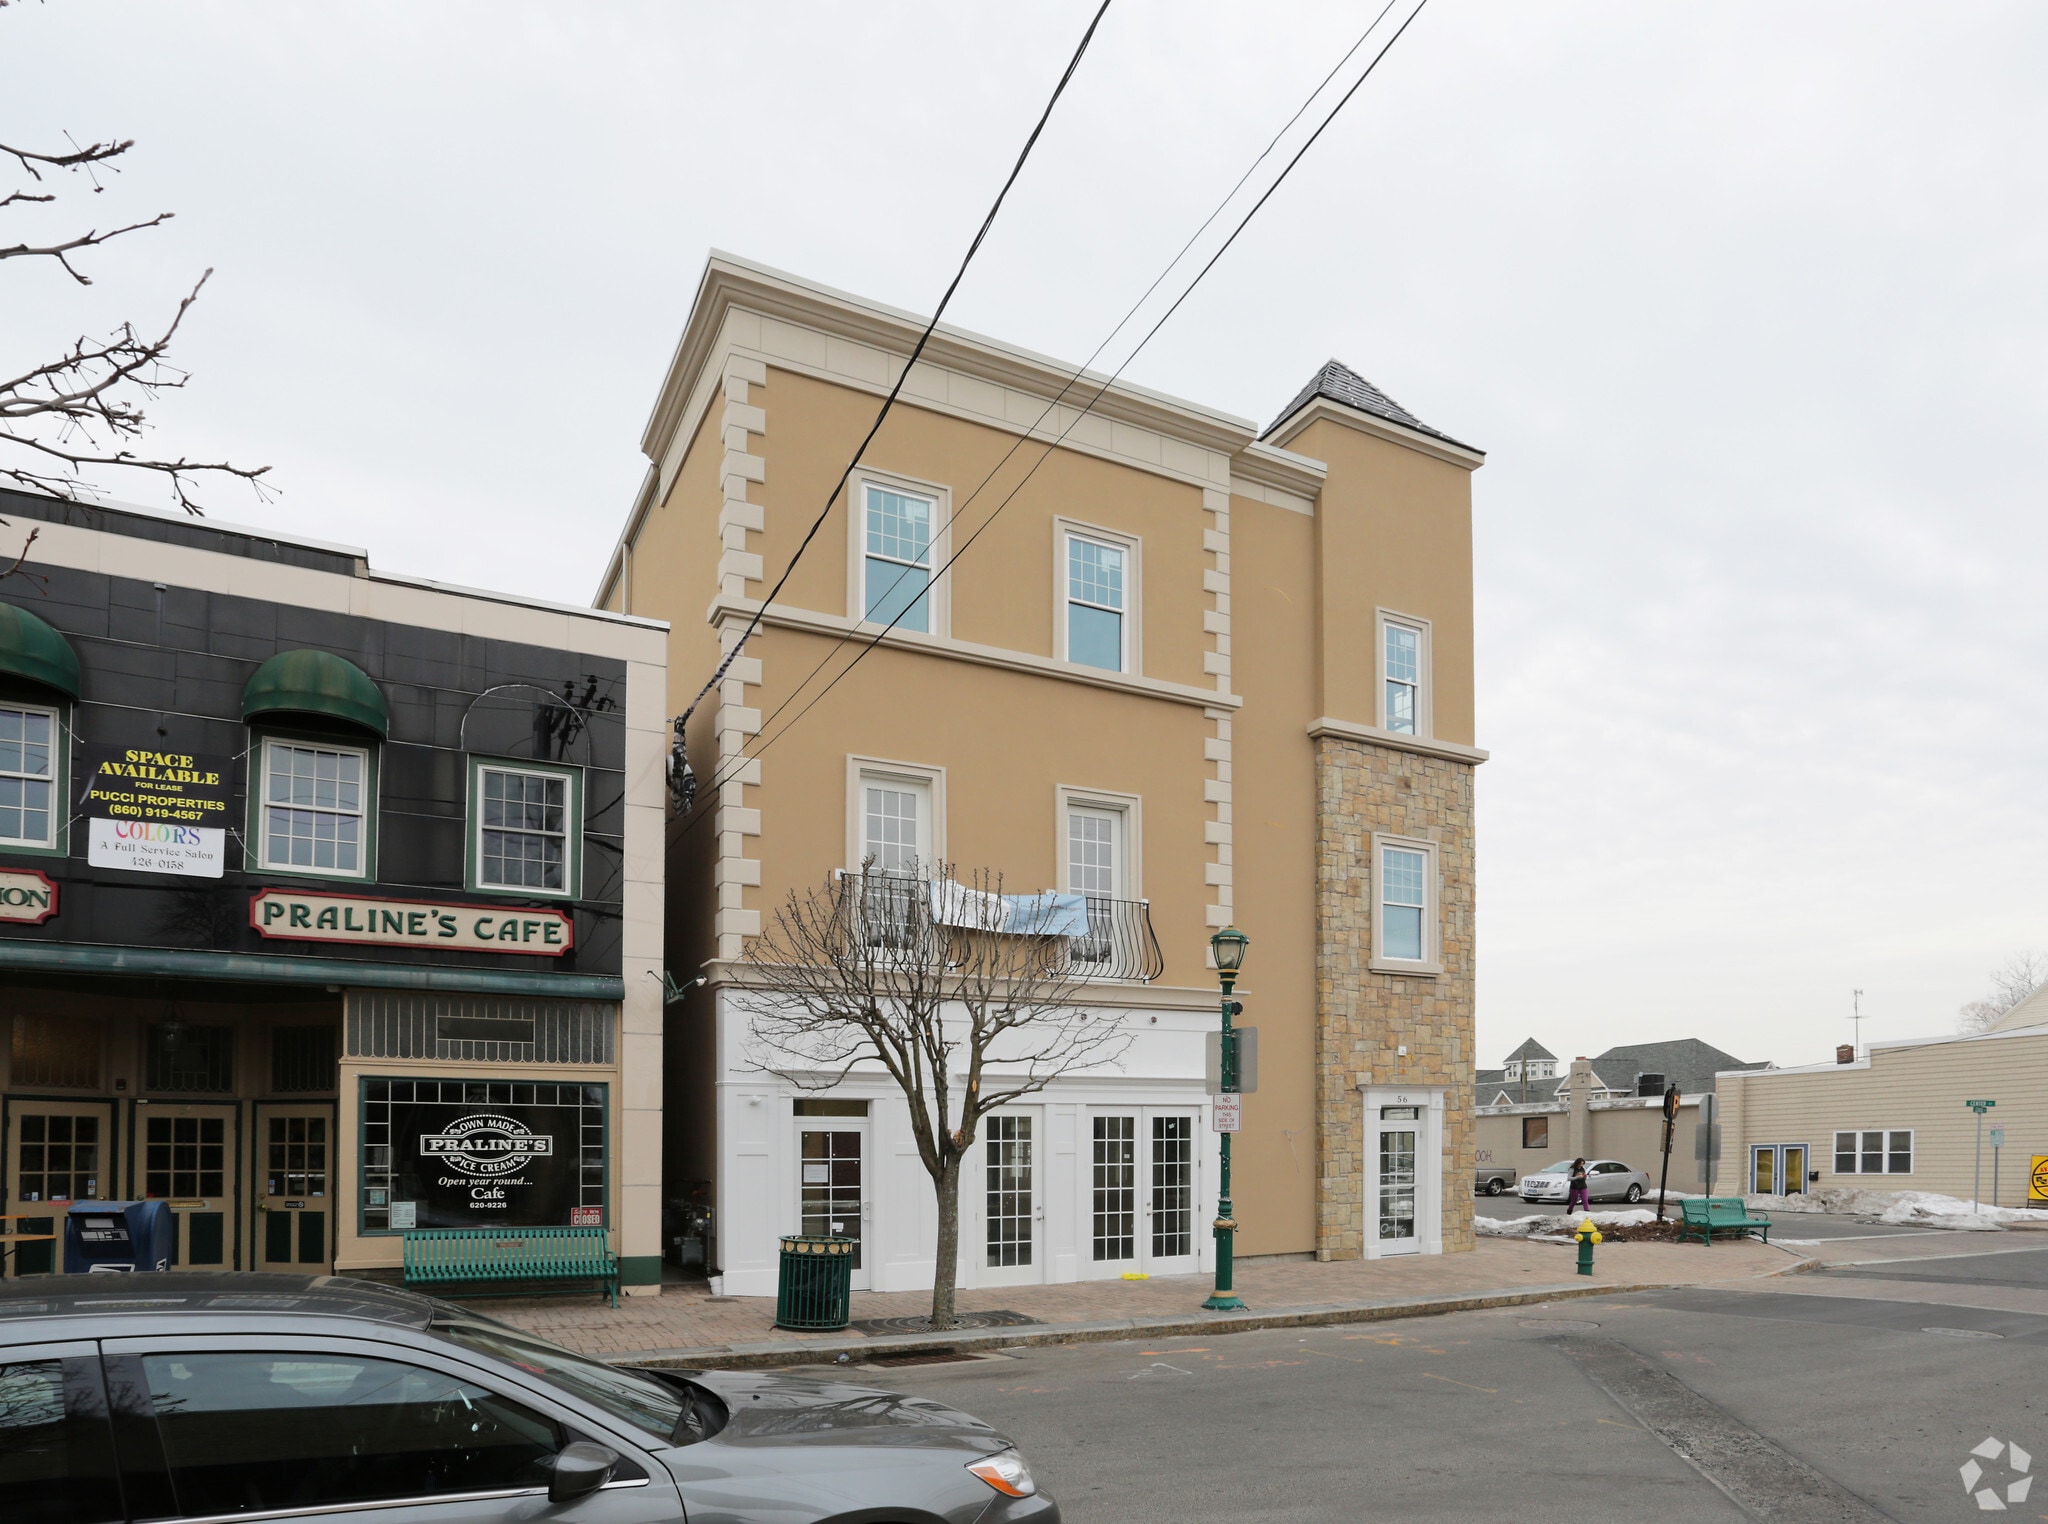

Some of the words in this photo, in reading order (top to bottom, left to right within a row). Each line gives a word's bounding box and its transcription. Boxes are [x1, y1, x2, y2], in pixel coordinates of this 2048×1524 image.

[125, 750, 193, 769] SPACE
[98, 761, 219, 785] AVAILABLE
[135, 781, 153, 790] FOR
[155, 783, 183, 792] LEASE
[90, 790, 135, 803] PUCCI
[138, 794, 225, 811] PROPERTIES
[109, 804, 142, 817] (860)
[145, 809, 203, 821] 919-4567
[115, 820, 201, 846] COLORS
[100, 841, 109, 849] A
[114, 842, 136, 852] Full
[141, 845, 181, 857] Service
[185, 848, 213, 861] Salon
[263, 901, 458, 938] PRALINE'S
[473, 916, 562, 944] CAFE
[1397, 1095, 1408, 1104] 56
[1672, 1094, 1680, 1115] P
[459, 1119, 484, 1132] OWN
[487, 1119, 516, 1133] MADE
[428, 1139, 547, 1151] PRALINE'S
[459, 1159, 477, 1171] ICE
[480, 1159, 516, 1173] CREAM
[438, 1176, 466, 1187] Open
[468, 1178, 492, 1187] year
[471, 1186, 505, 1200] Cafe
[573, 1214, 600, 1225] COSED
